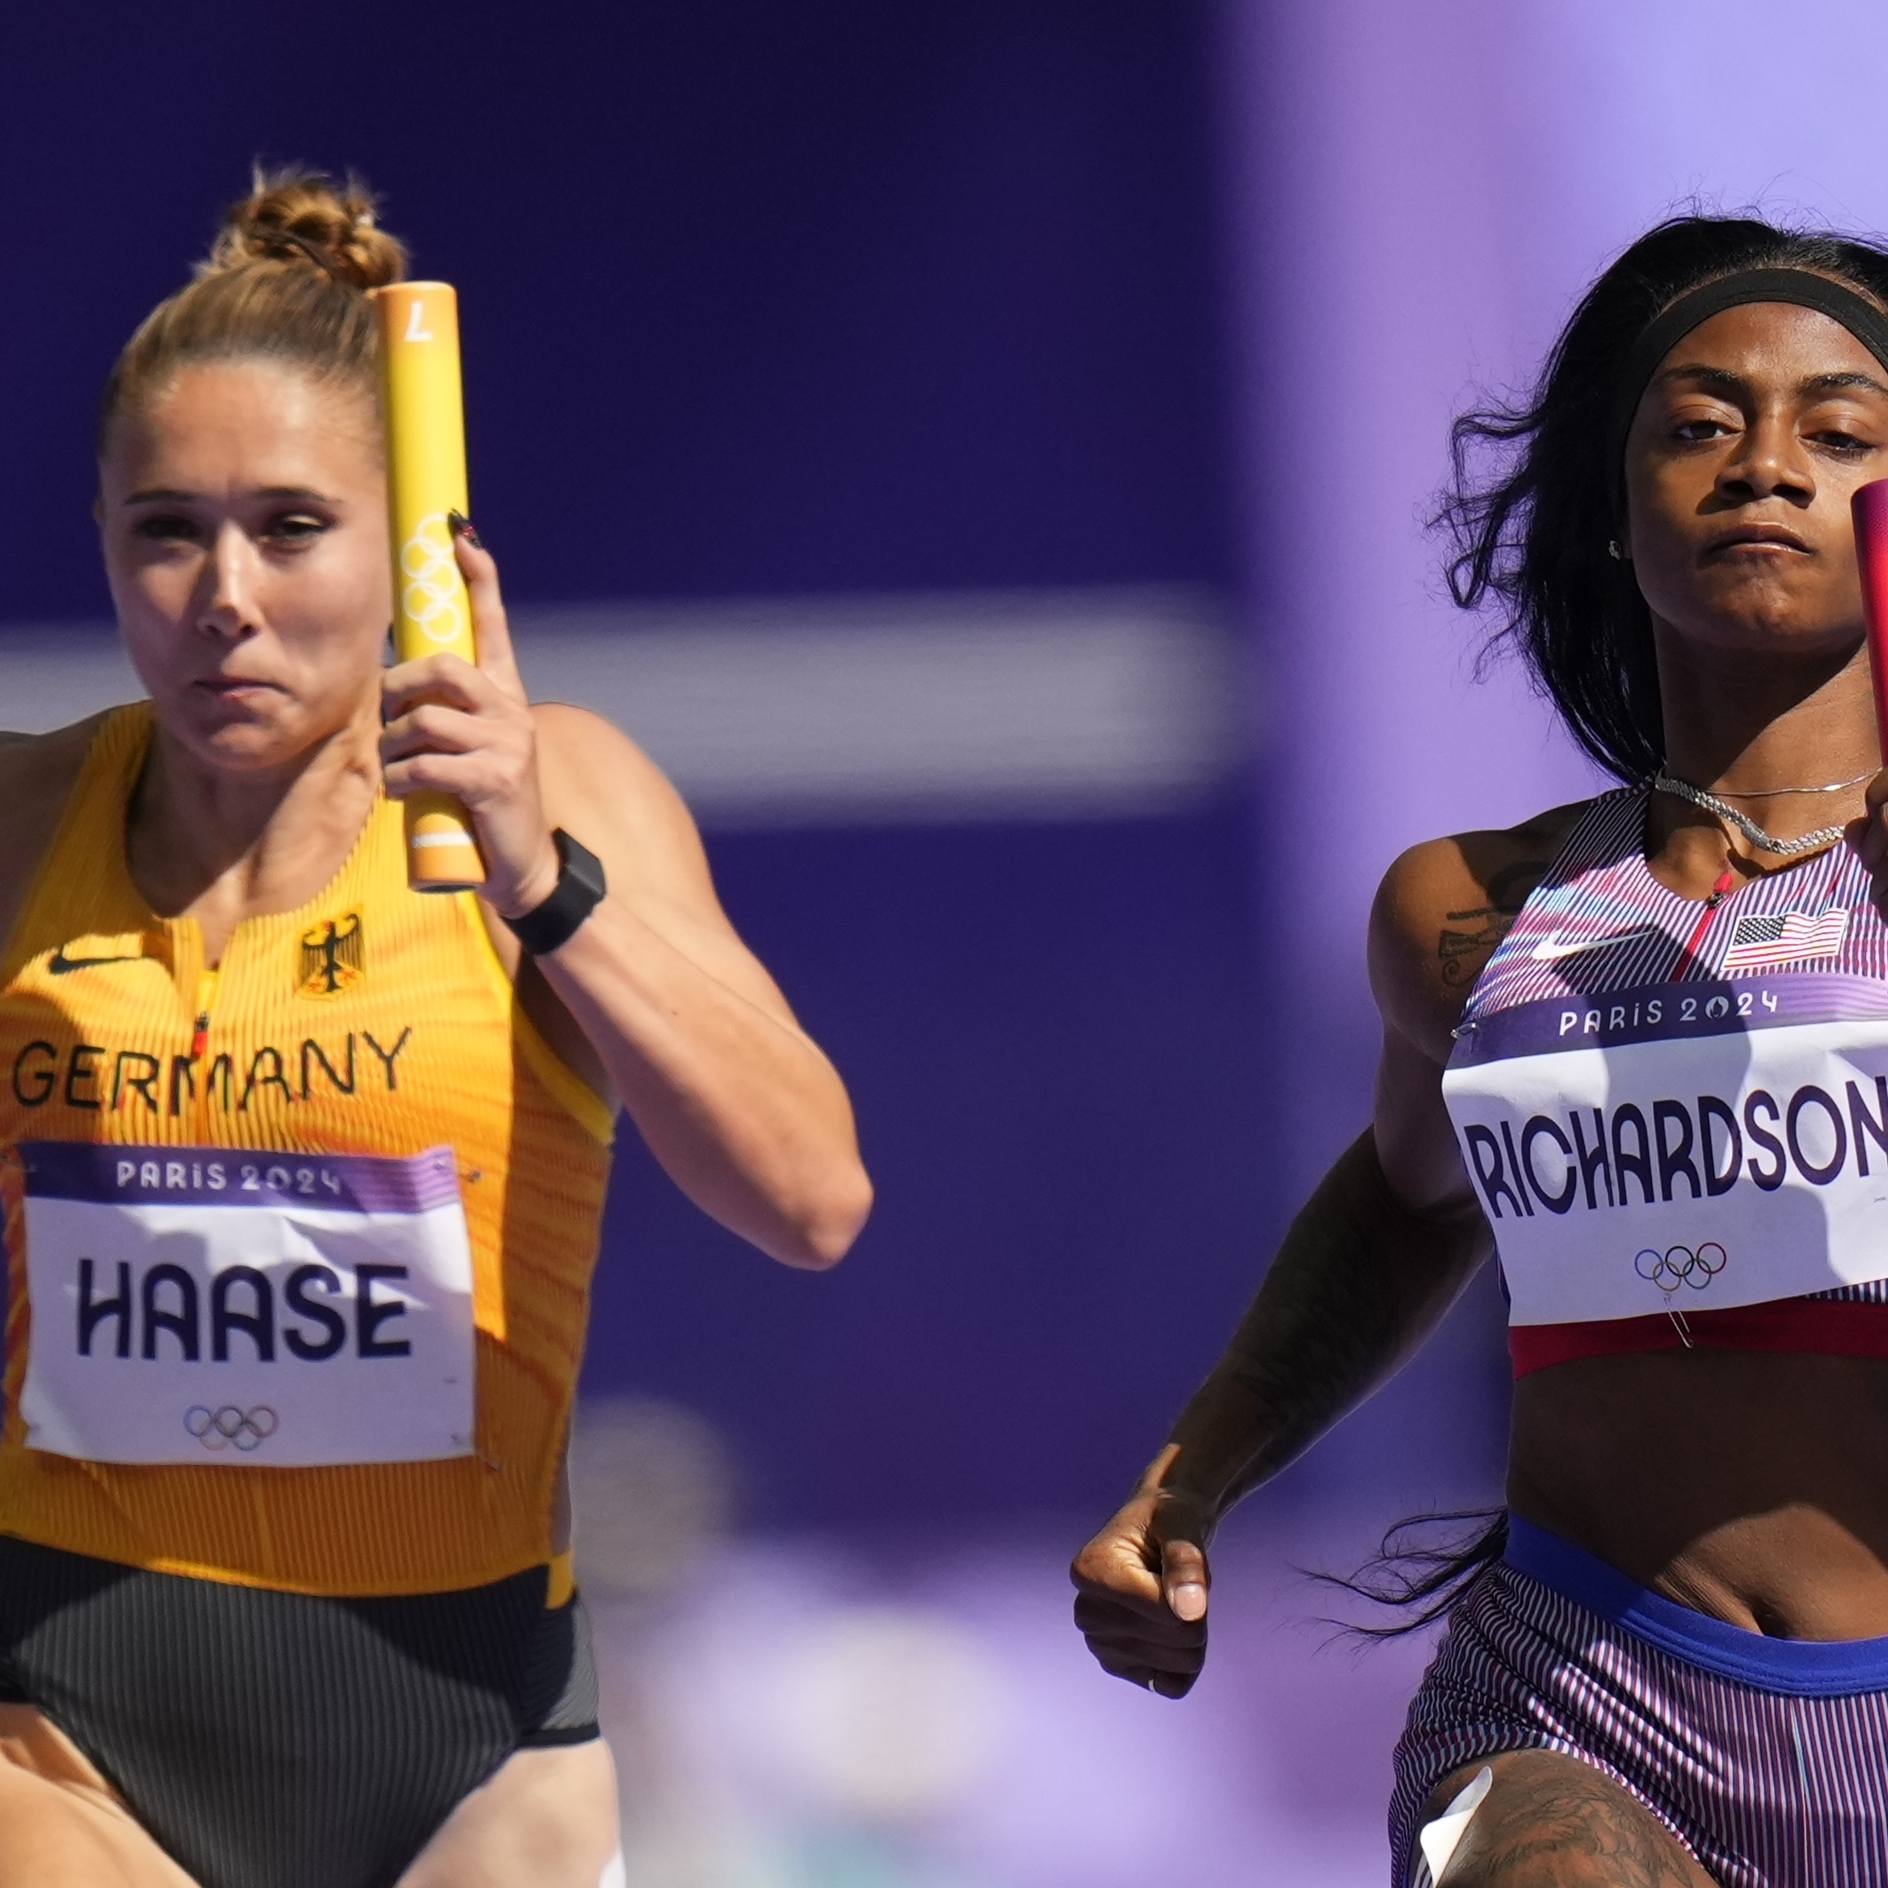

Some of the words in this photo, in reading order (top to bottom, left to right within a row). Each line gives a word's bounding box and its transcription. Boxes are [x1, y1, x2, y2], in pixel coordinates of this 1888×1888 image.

[1679, 990, 1778, 1022] 2024
[13, 1027, 412, 1117] GERMANY
[240, 1164, 342, 1195] 2024
[75, 1257, 413, 1362] HAASE
